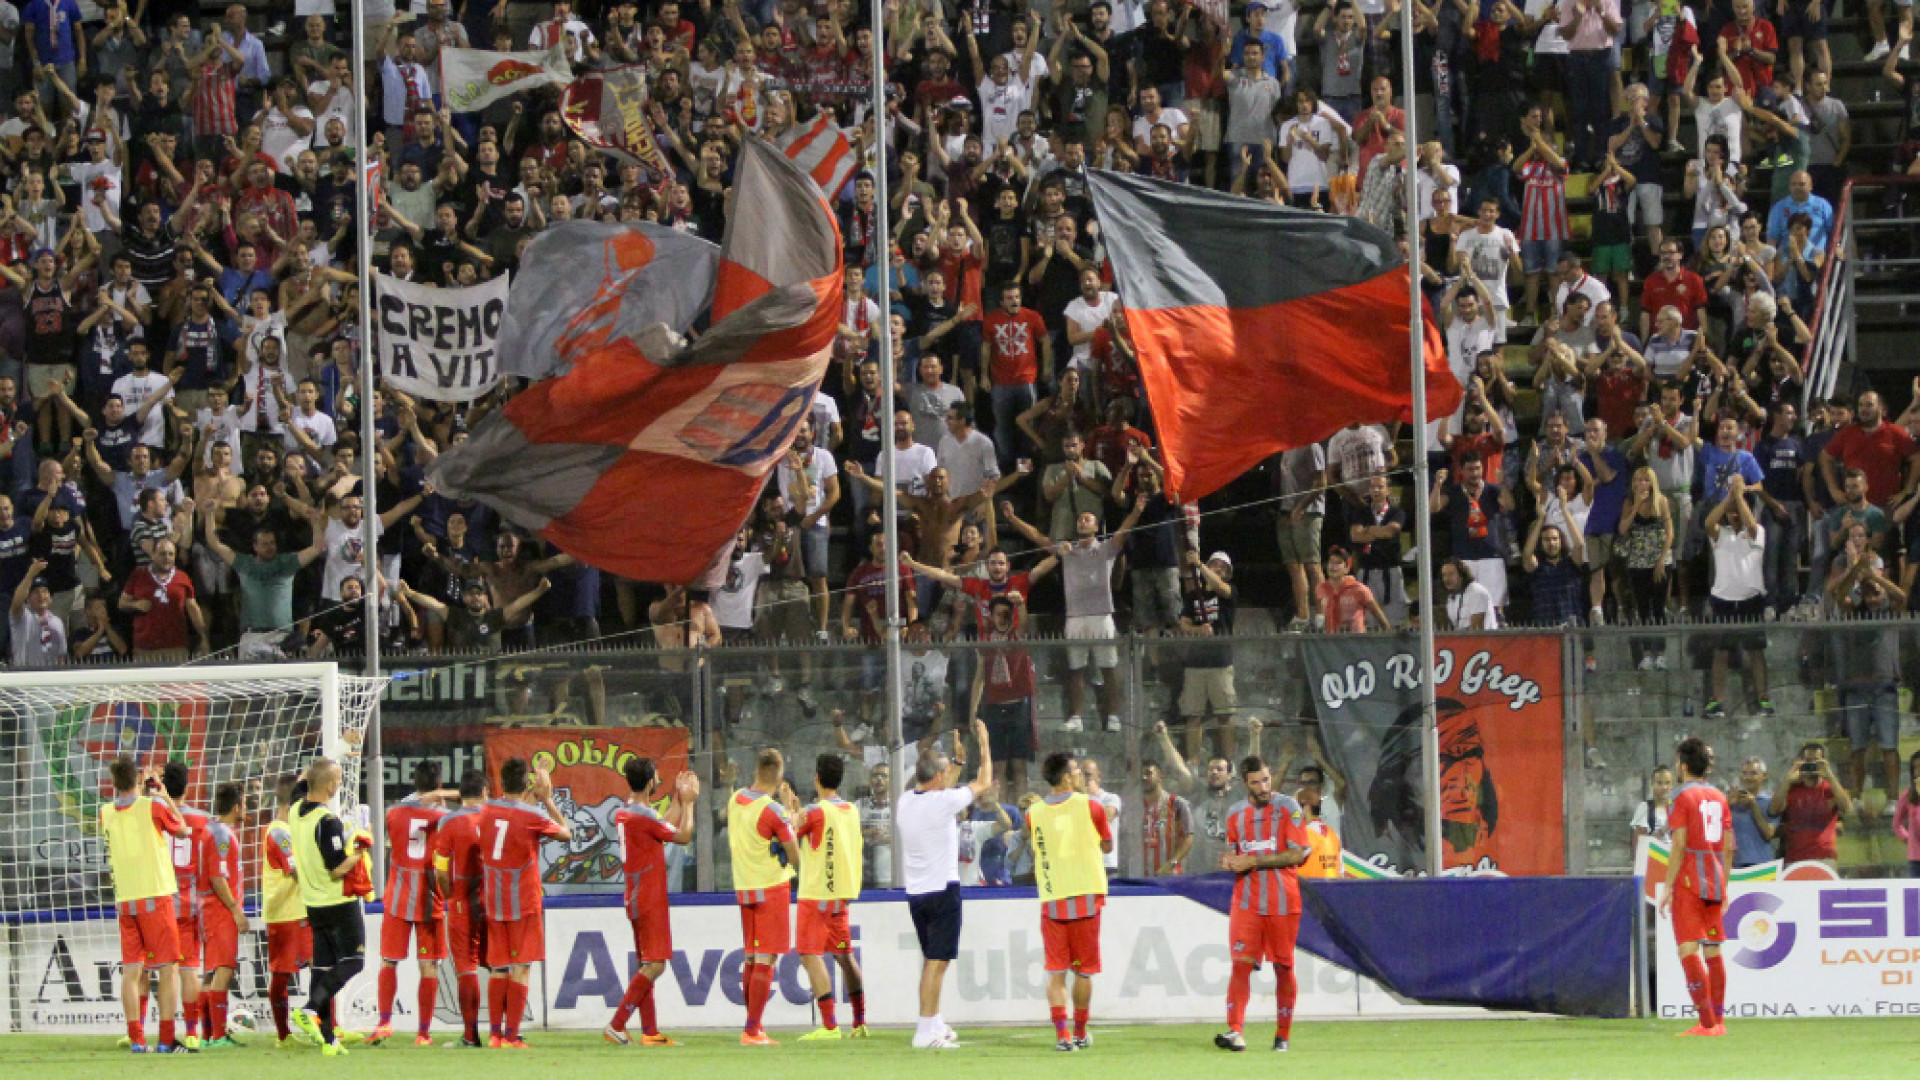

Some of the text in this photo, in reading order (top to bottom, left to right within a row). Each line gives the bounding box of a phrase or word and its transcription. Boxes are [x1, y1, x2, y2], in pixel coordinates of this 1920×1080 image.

[379, 294, 503, 349] CREMO
[391, 343, 498, 388] A VIT
[1321, 648, 1542, 710] Old Rd Grey
[406, 818, 429, 860] 5
[492, 818, 510, 861] 7
[1699, 799, 1723, 843] 13
[1881, 970, 1913, 985] DI
[1662, 1002, 1798, 1018] CRMONA
[1827, 1003, 1863, 1016] VIA
